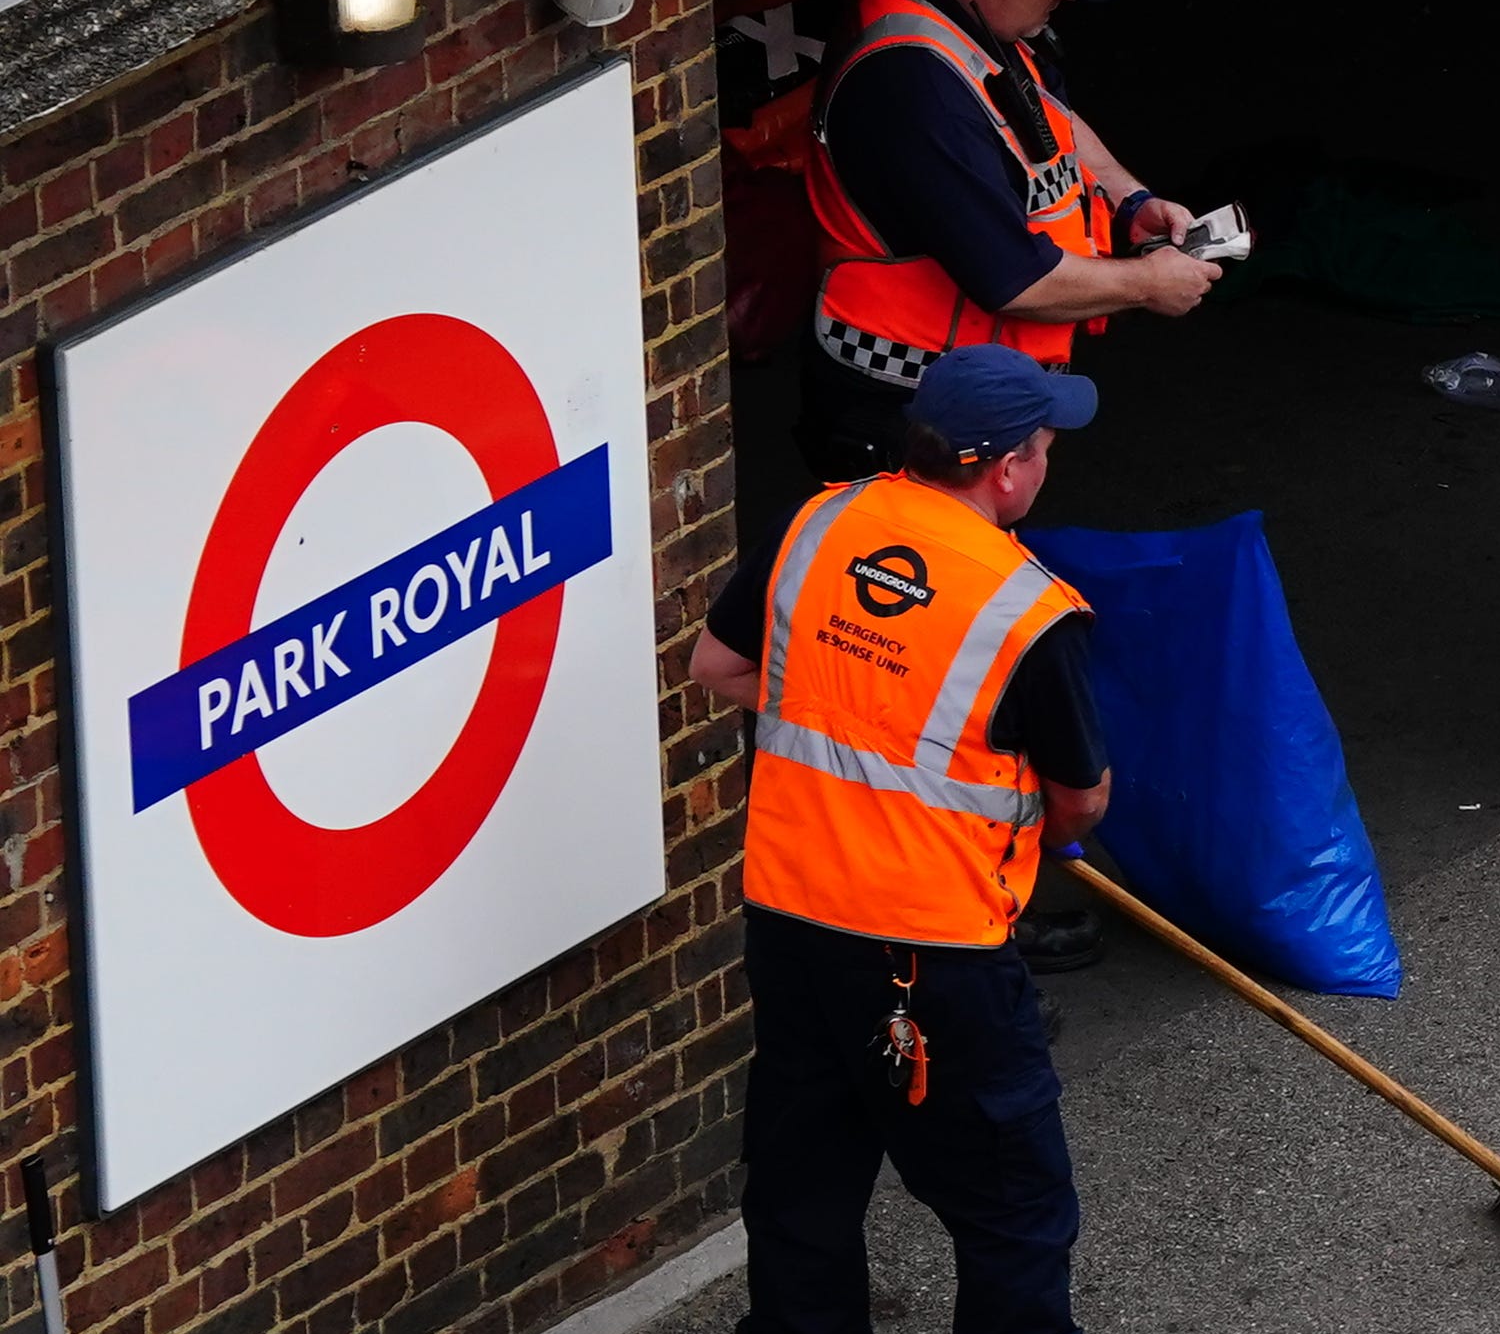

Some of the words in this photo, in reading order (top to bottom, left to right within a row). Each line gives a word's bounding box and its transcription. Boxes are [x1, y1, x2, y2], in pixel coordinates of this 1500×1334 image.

[854, 563, 927, 600] UNDERGROUND
[198, 609, 351, 751] PARK
[370, 509, 551, 660] ROYAL
[828, 614, 907, 655] EMERGENCY
[875, 654, 911, 678] UNIT
